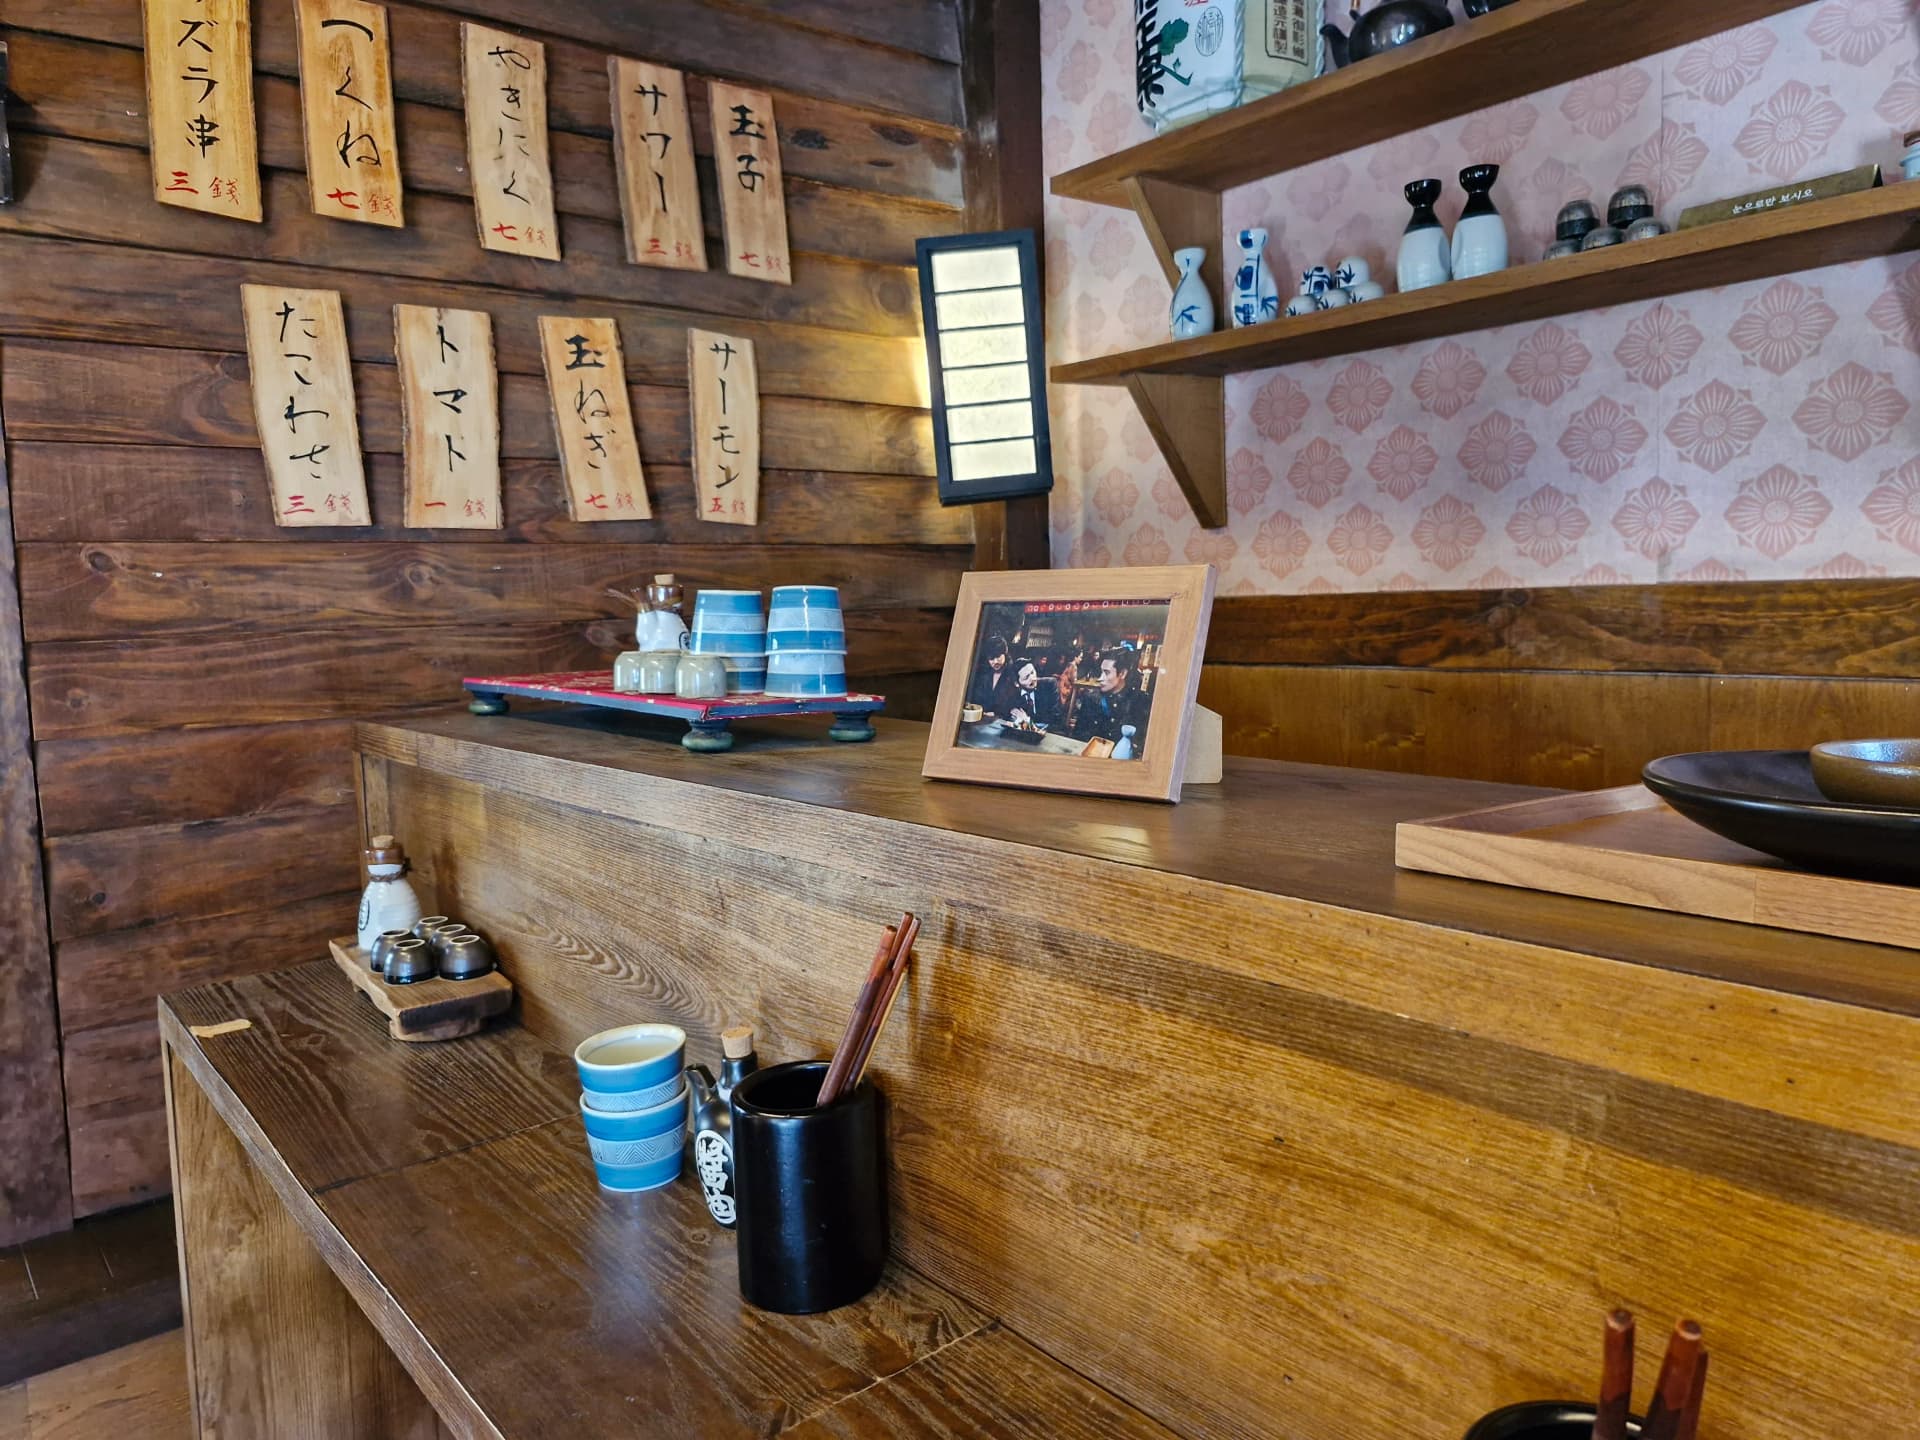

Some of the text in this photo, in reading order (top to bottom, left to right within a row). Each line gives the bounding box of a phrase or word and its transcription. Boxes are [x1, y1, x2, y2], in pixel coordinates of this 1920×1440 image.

[177, 0, 220, 159] ズラ串
[321, 19, 381, 168] つくね
[633, 84, 672, 213] サワー
[729, 104, 767, 192] 玉子
[1778, 189, 1813, 203] 보시오
[275, 301, 330, 479] たこわさ
[433, 325, 467, 472] トマト
[564, 334, 616, 469] 玉ねぎ
[709, 342, 740, 488] サーモン
